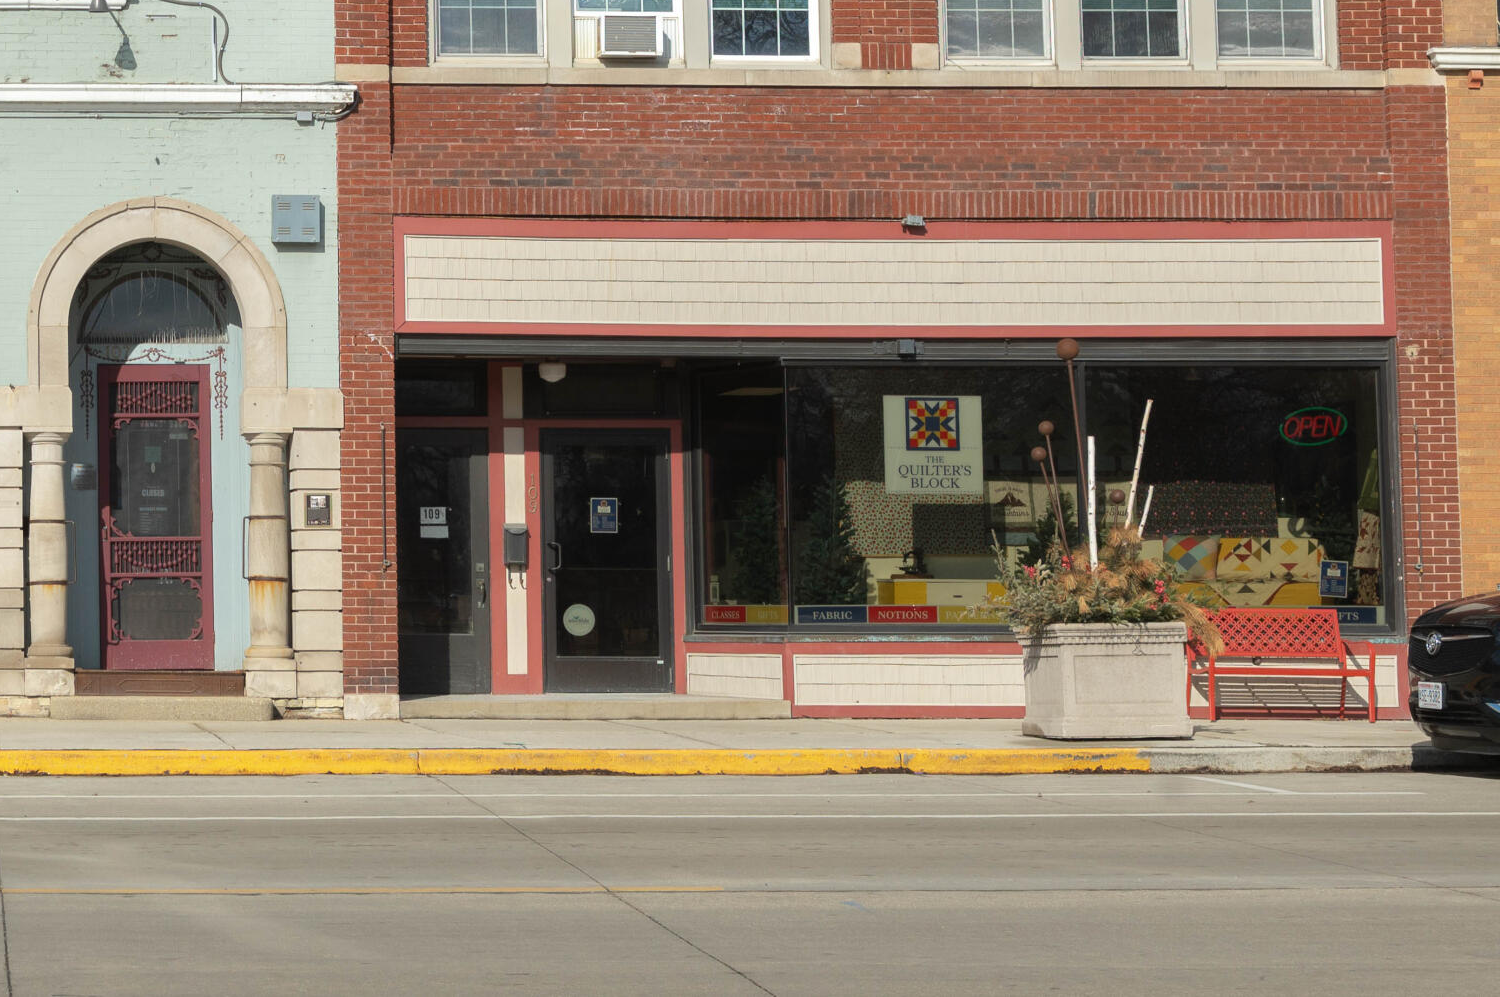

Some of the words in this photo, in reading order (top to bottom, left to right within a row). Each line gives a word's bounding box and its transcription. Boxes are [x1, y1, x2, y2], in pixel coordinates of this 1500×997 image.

[1284, 415, 1342, 439] OPEN
[925, 455, 945, 464] THE
[898, 464, 972, 478] QUILTER'S
[911, 478, 961, 489] BLOCK
[711, 610, 740, 620] CLASSES
[812, 610, 853, 620] FABRIC
[877, 610, 929, 620] NOTIONS
[1339, 611, 1360, 621] FTS
